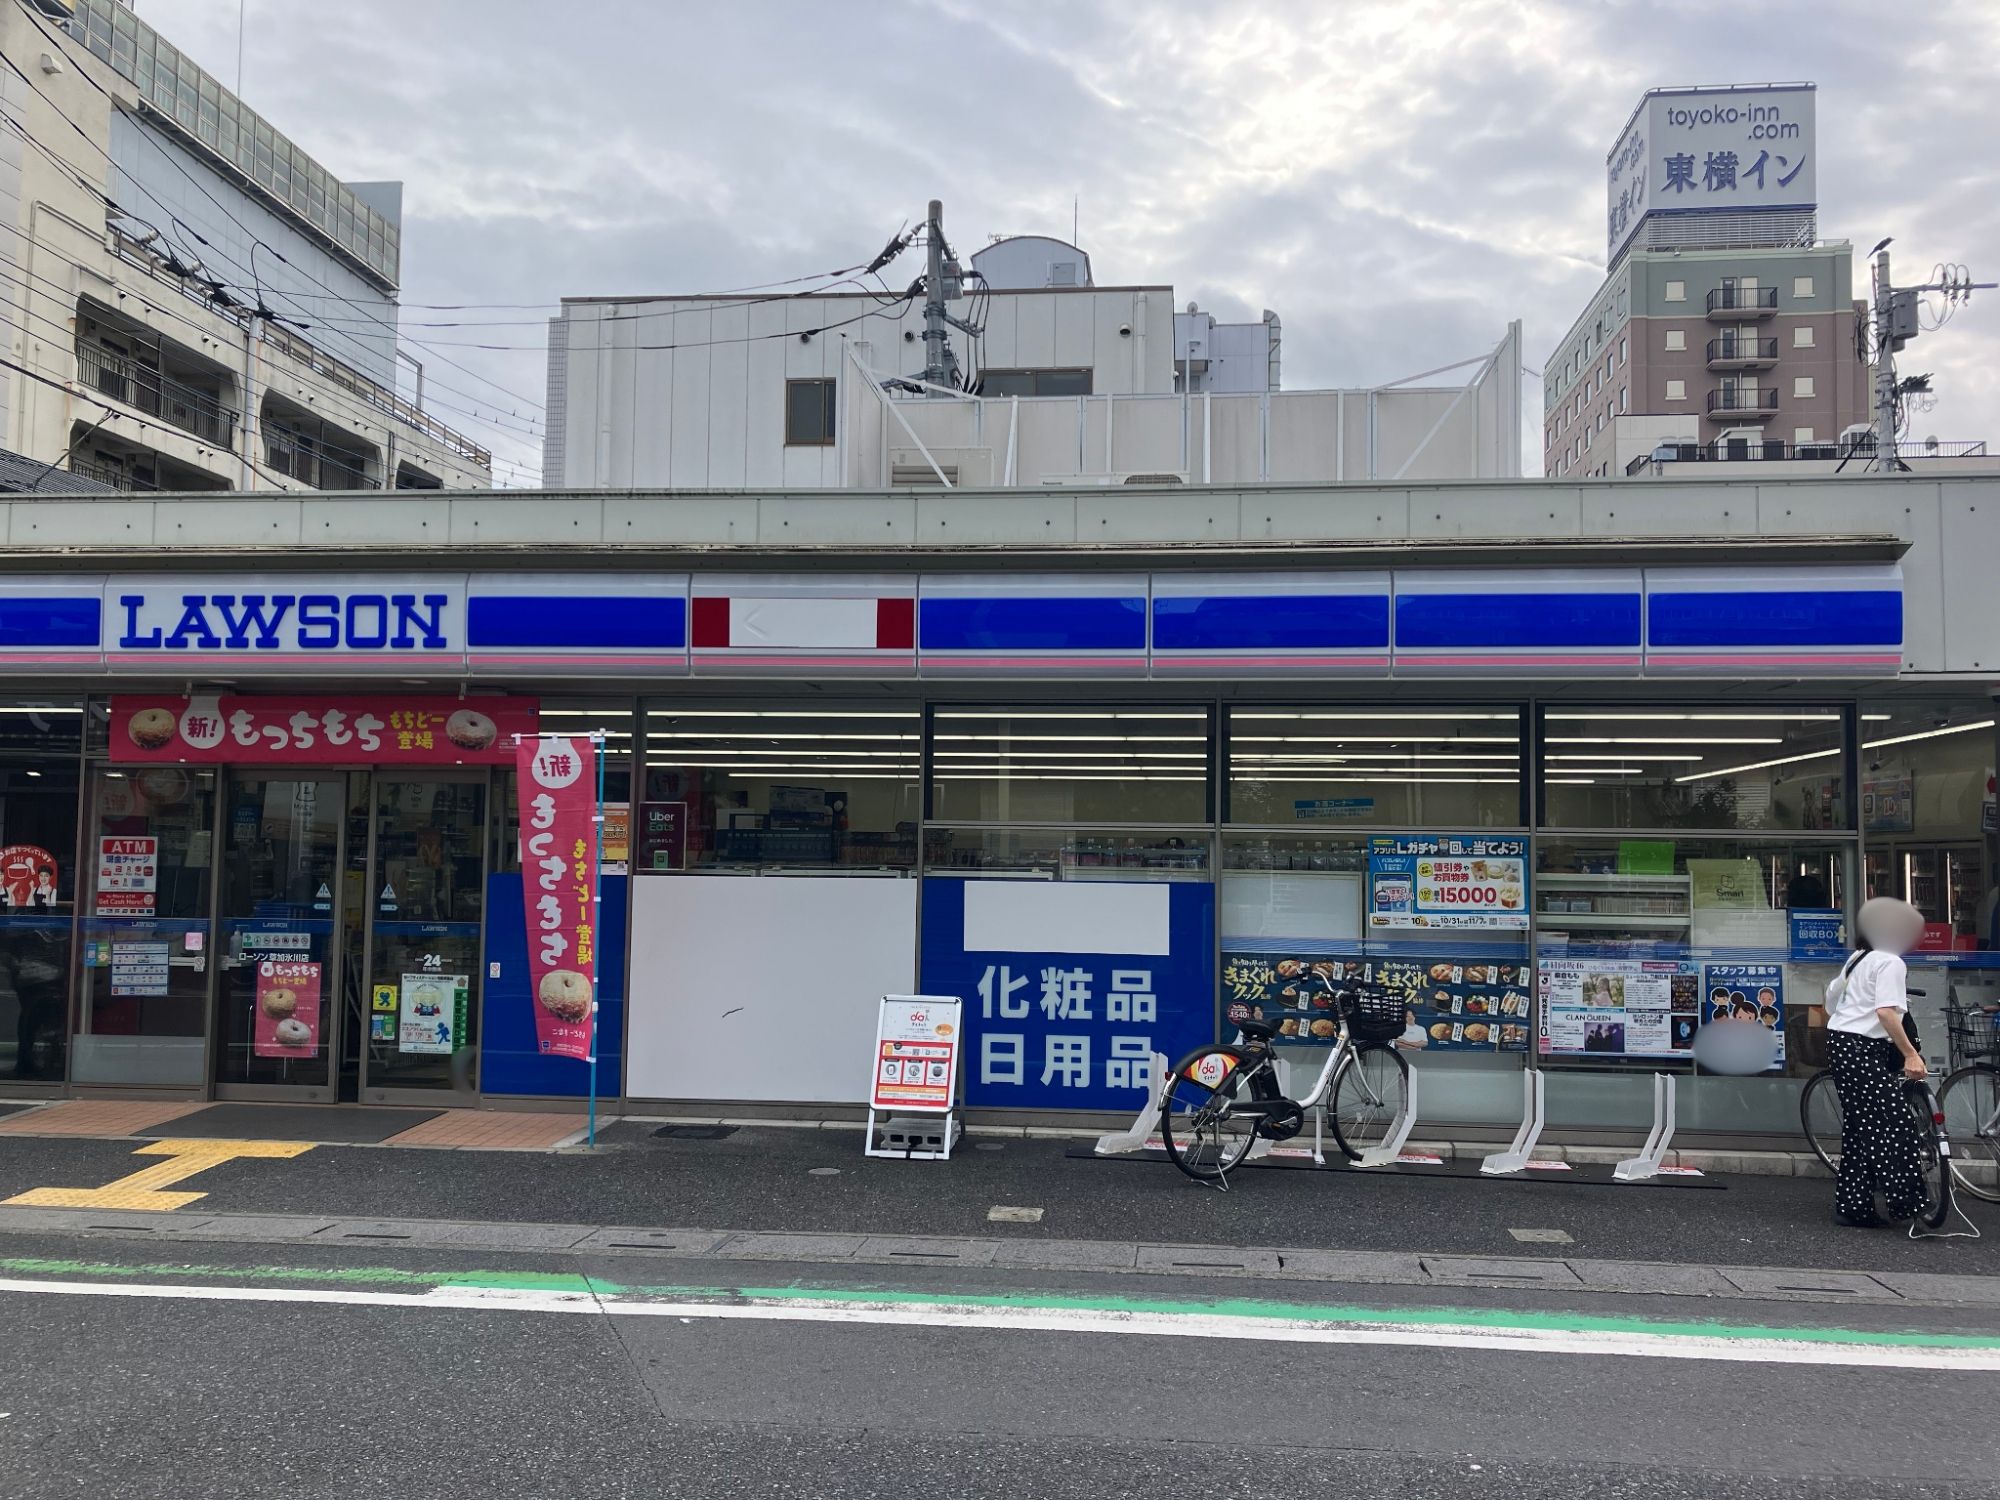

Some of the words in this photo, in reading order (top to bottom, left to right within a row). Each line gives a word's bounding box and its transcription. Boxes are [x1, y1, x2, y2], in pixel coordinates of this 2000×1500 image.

[1667, 103, 1780, 130] toyoko-inn
[1747, 123, 1800, 141] .com
[1660, 149, 1806, 194] 東横イン
[119, 594, 450, 649] LAWSON
[389, 710, 446, 730] もちどー
[186, 716, 218, 739] 新!
[228, 708, 386, 752] もっちもち
[397, 731, 436, 750] 登場
[649, 811, 675, 822] Uber
[649, 822, 675, 832] Eats
[112, 841, 147, 854] ATM
[1439, 886, 1498, 904] 15,000
[423, 953, 442, 967] 24
[1223, 966, 1278, 986] きまぐれ
[1711, 966, 1777, 975] スタッフ募集中
[977, 965, 1157, 1023] 化粧品
[1586, 1013, 1612, 1022] QUEEN
[980, 1033, 1152, 1089] 日用品
